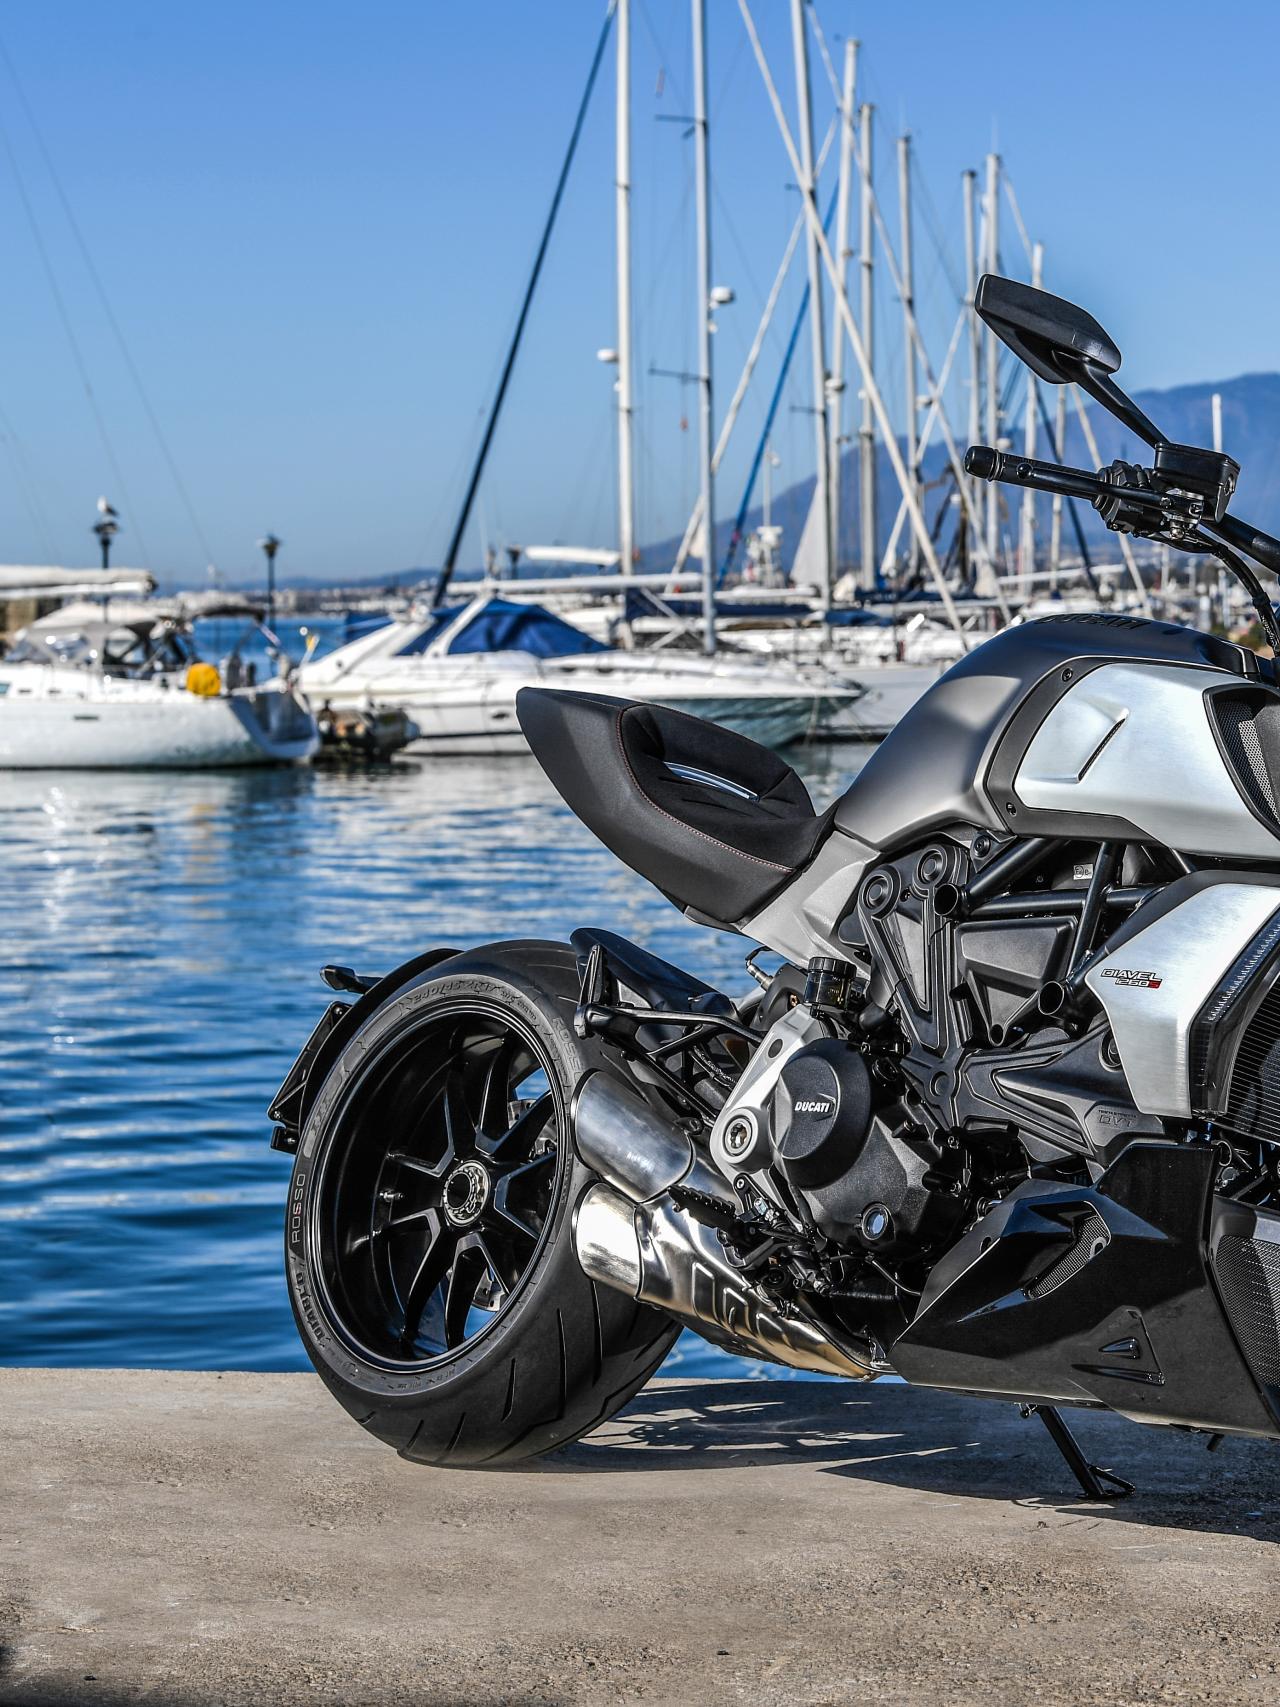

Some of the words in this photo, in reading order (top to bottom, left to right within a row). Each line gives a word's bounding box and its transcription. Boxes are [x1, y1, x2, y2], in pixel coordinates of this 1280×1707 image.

[1101, 969, 1162, 982] DIAVEL
[794, 1101, 830, 1113] DUCATI
[291, 1173, 306, 1244] ROSSO
